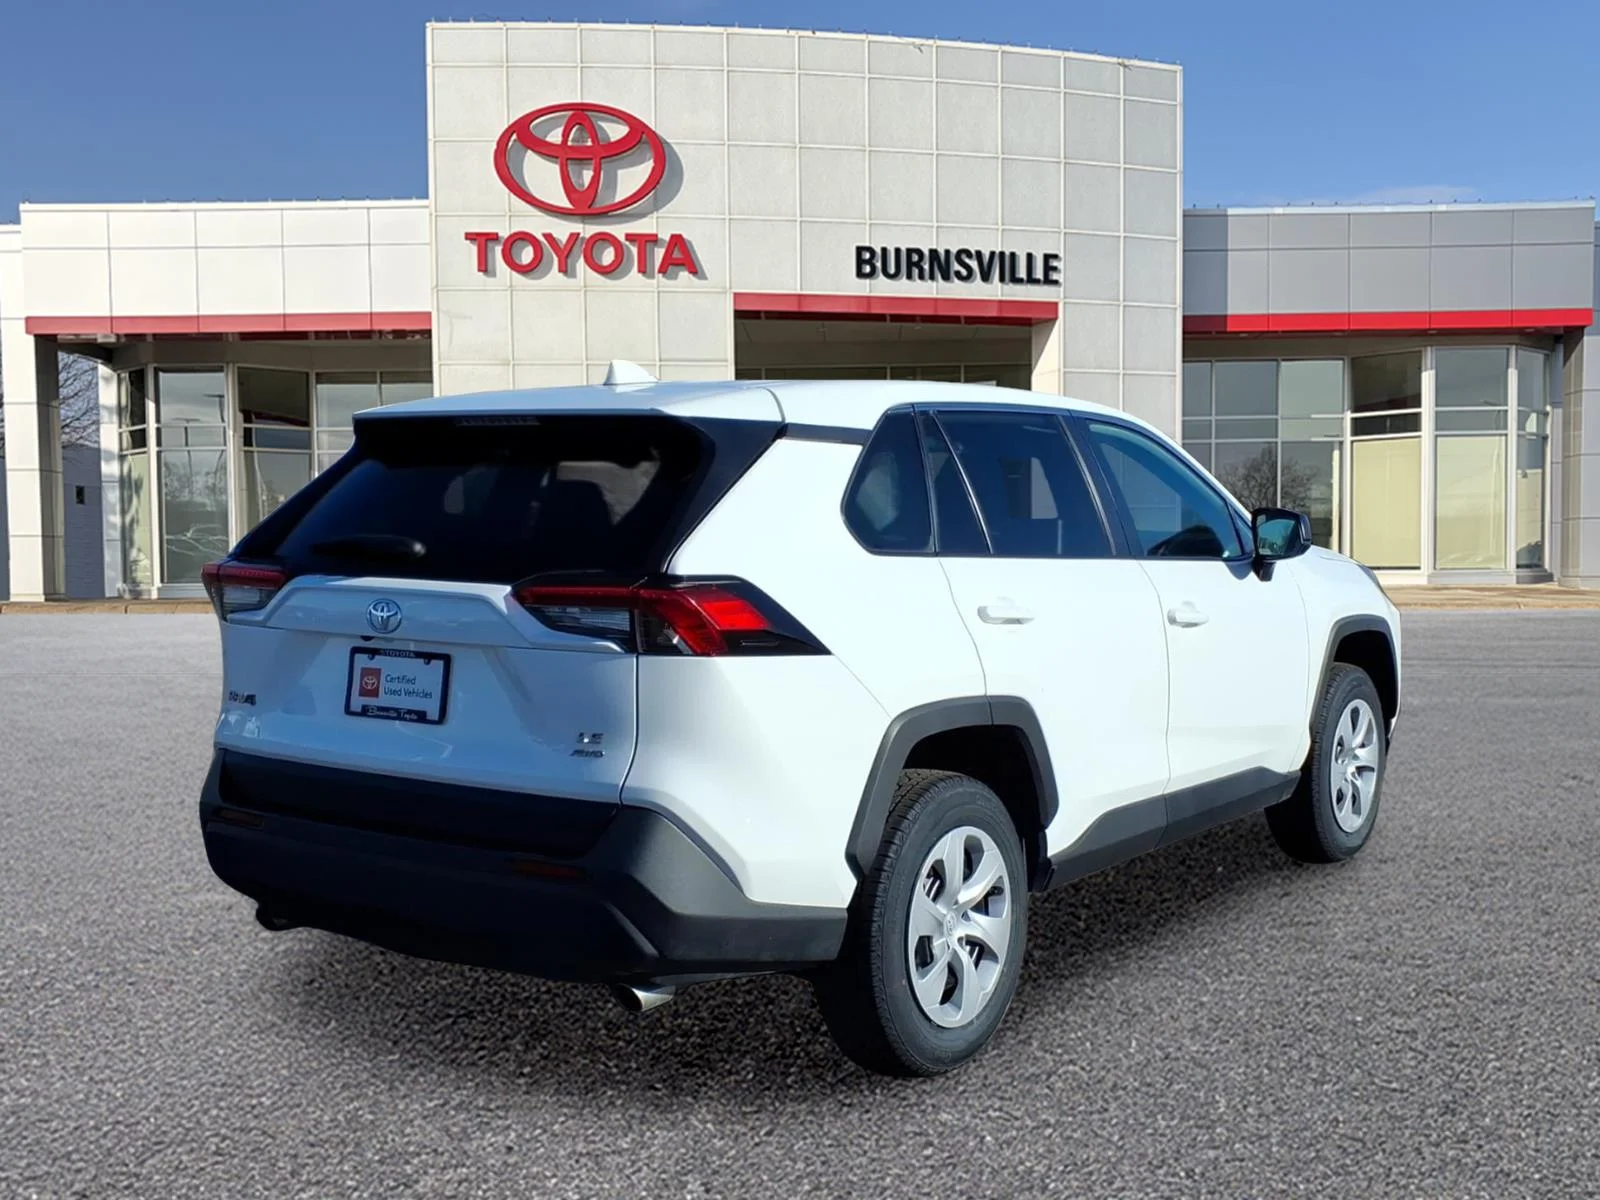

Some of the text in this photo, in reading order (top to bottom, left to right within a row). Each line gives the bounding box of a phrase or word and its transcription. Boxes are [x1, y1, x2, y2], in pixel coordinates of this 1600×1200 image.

[465, 231, 698, 276] TOYOTA
[855, 246, 1061, 286] BURNSVILLE
[383, 686, 433, 698] Used Vehicles
[384, 674, 416, 685] Certified
